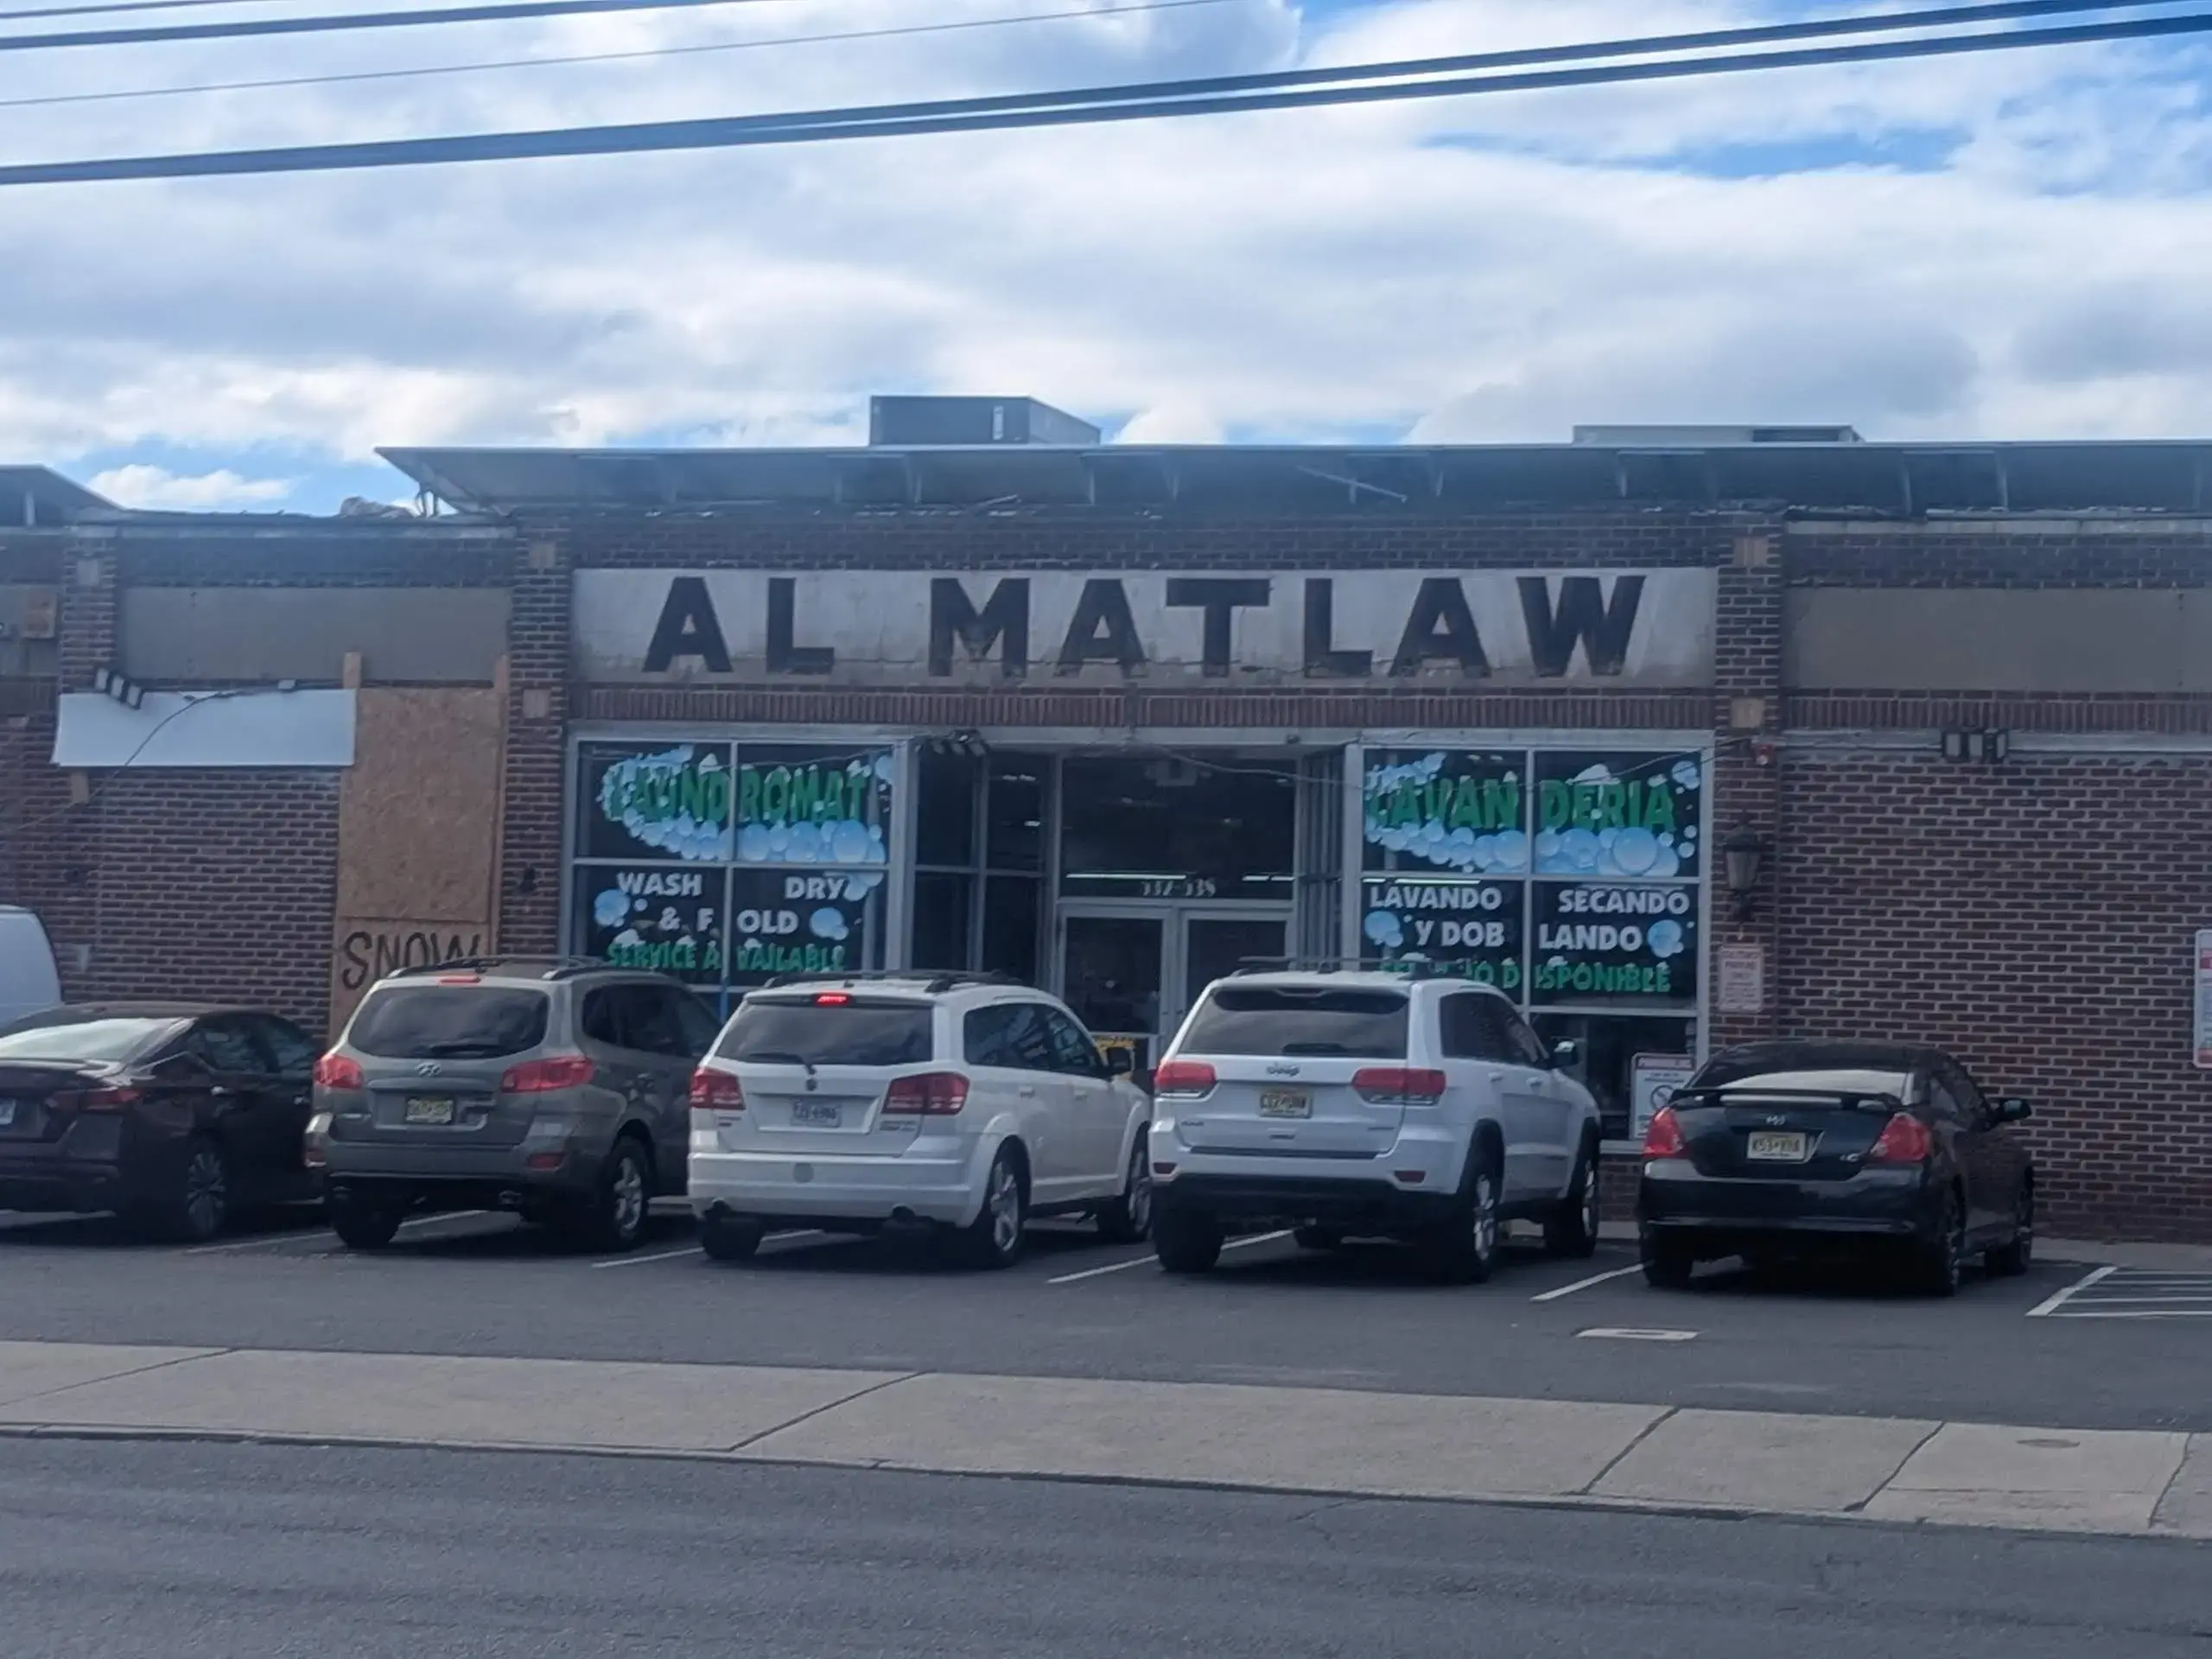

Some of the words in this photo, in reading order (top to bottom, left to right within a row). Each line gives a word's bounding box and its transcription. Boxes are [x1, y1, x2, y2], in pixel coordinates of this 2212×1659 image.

[641, 575, 836, 675] AL
[926, 575, 1648, 678] MATLAW
[617, 872, 703, 896] WASH
[785, 876, 848, 900] DRY
[1370, 886, 1503, 911] LAVANDO
[1557, 888, 1690, 914] SECANDO
[658, 907, 682, 931] &
[1414, 919, 1434, 945] Y
[342, 931, 480, 989] SNOW
[607, 943, 697, 969] SERVICE
